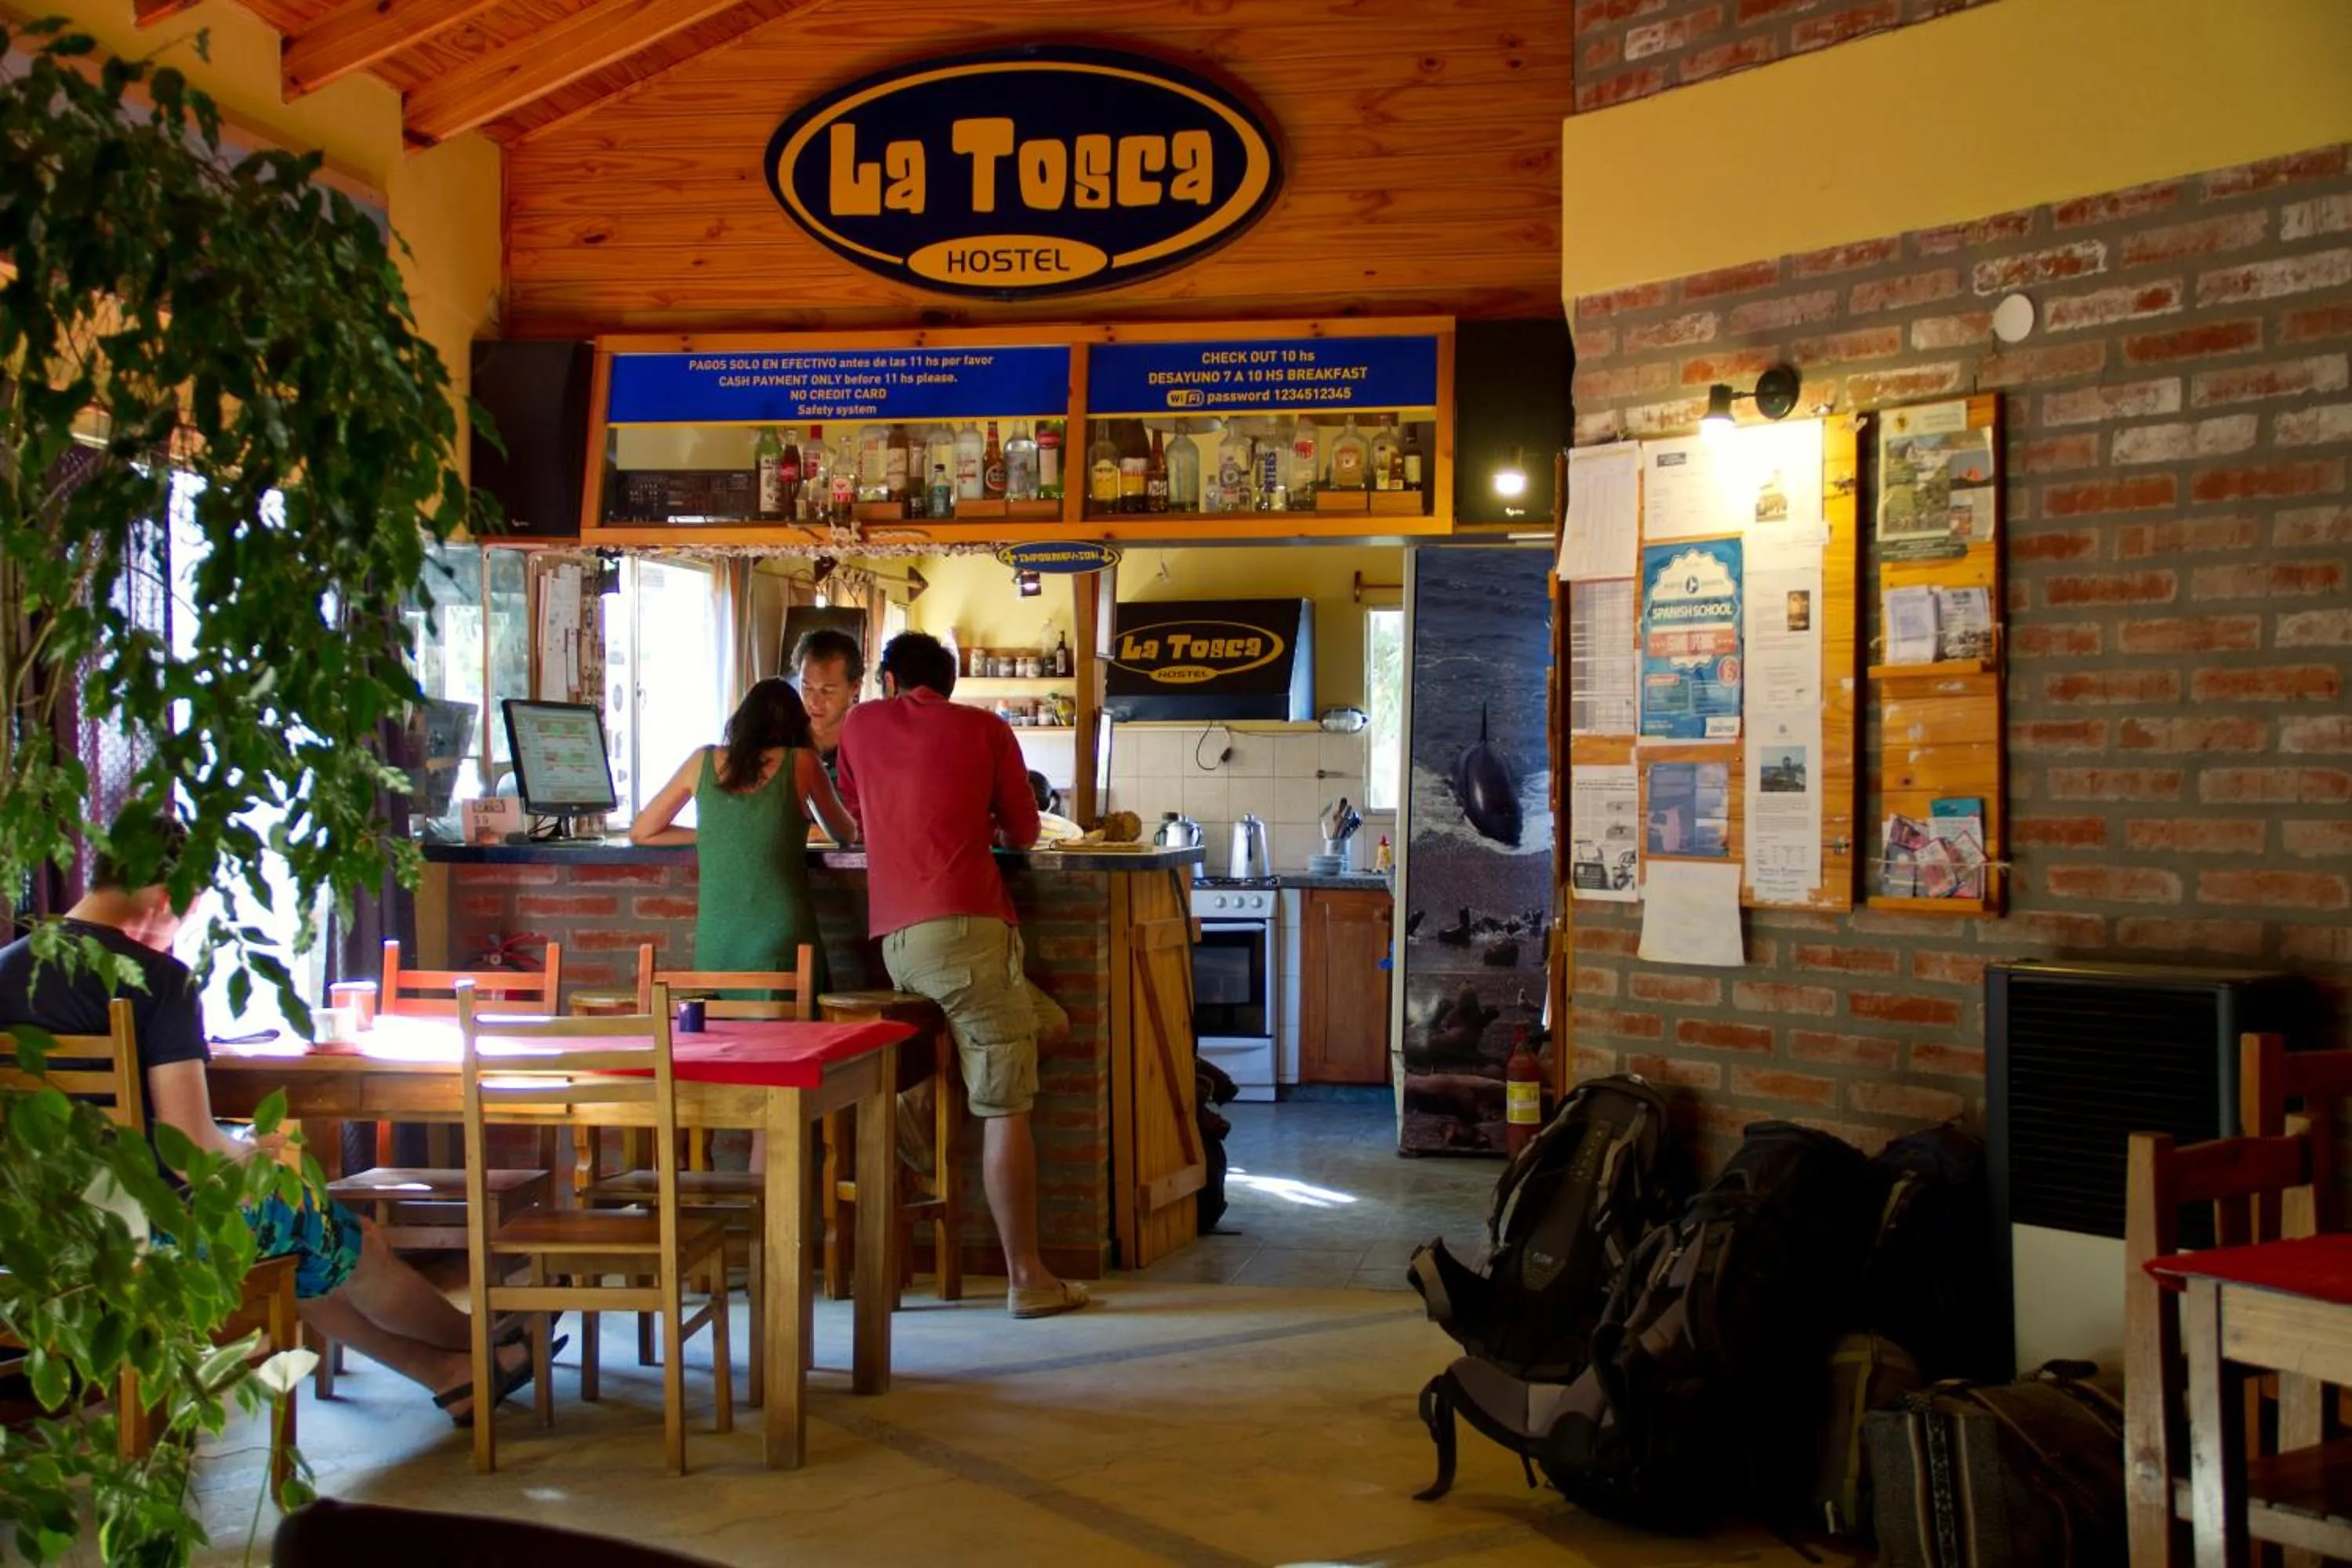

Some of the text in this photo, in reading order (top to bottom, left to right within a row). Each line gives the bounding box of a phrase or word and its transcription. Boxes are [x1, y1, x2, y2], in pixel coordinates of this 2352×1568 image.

[831, 116, 1214, 217] La Tosca
[946, 247, 1071, 274] HOSTEL
[688, 355, 993, 371] PAGOS SOLO EN EFECTIVO antes de las 11 hs por favor
[1202, 350, 1316, 365] CHECK OUT 10 hs
[719, 372, 957, 387] CASH PAYMENT ONLY before 11 hs please.
[1149, 366, 1368, 385] DESAYUNO 7 A 10 HS BREAKFAST
[789, 388, 887, 401] NO CREDIT CARD
[1207, 389, 1271, 405] password
[1274, 387, 1352, 401] 1234512345
[797, 404, 877, 417] Safety system
[1653, 603, 1733, 620] SPANISH SCHOOL
[1120, 634, 1261, 660] La Tosca
